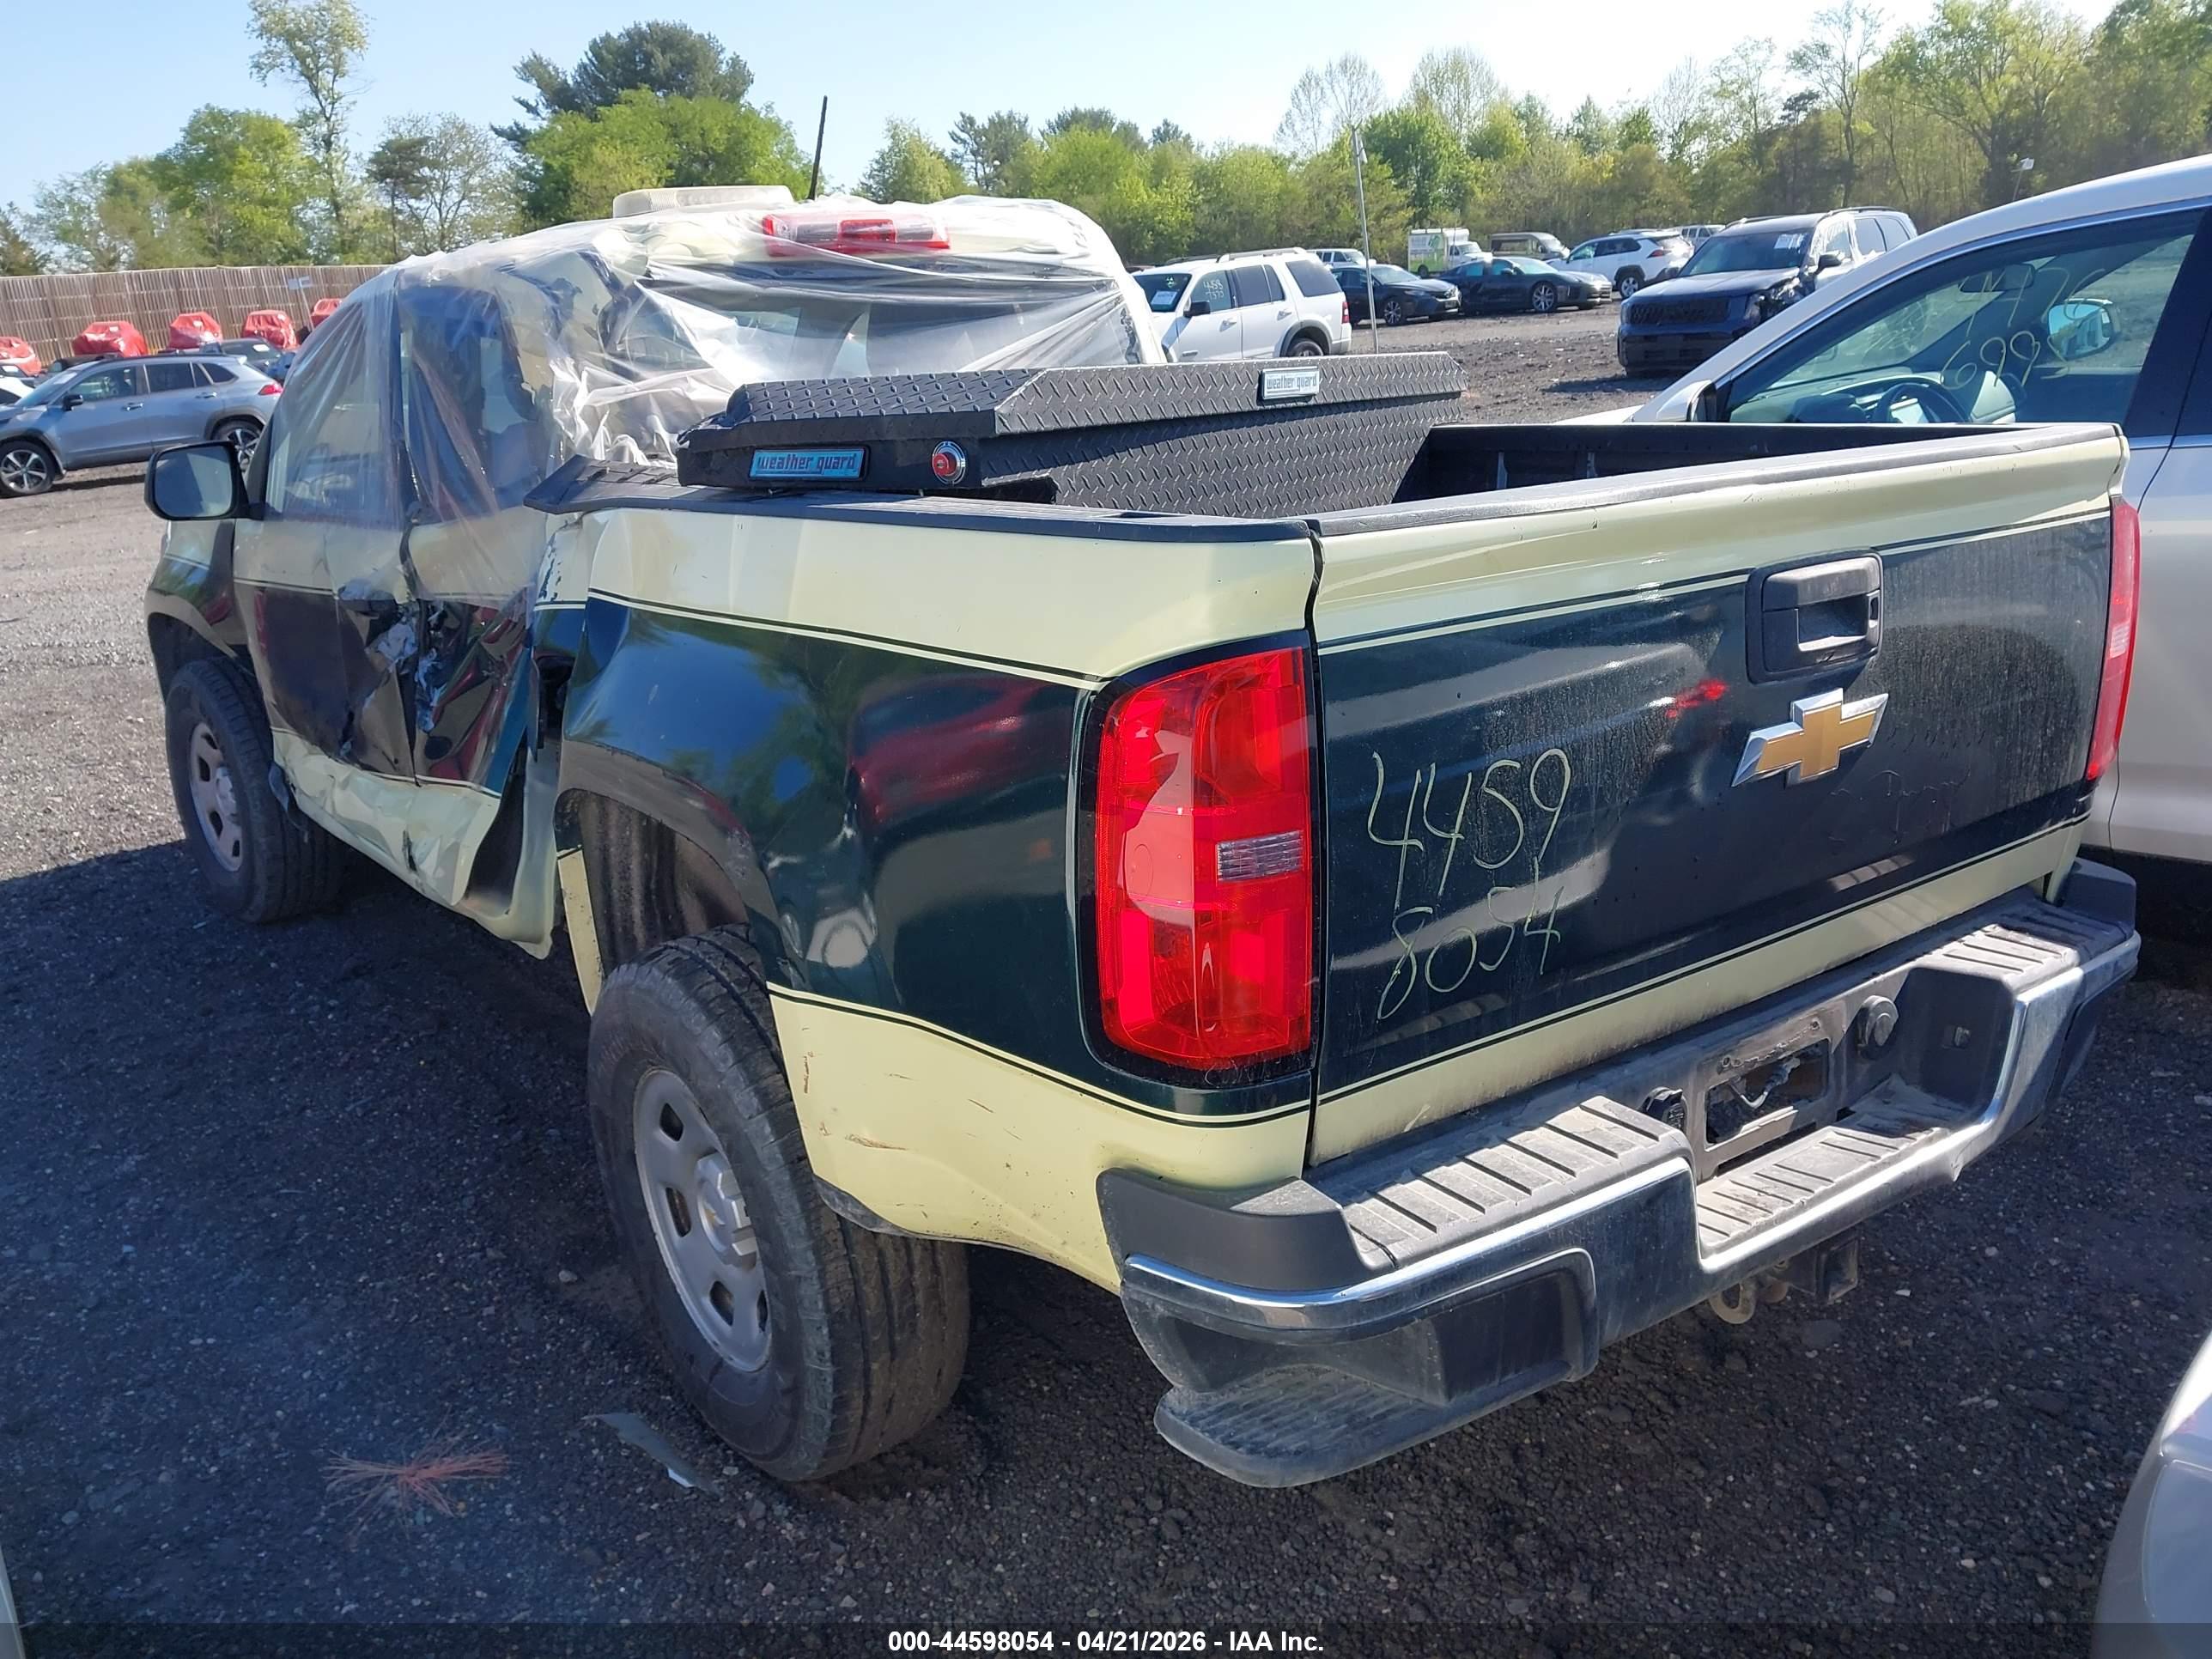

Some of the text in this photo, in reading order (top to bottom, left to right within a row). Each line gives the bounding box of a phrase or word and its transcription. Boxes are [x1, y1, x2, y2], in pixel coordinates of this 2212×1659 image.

[1267, 373, 1317, 392] weather guard
[757, 453, 858, 475] weather guard
[1367, 747, 1571, 910] 4459
[1376, 855, 1562, 1024] 8054
